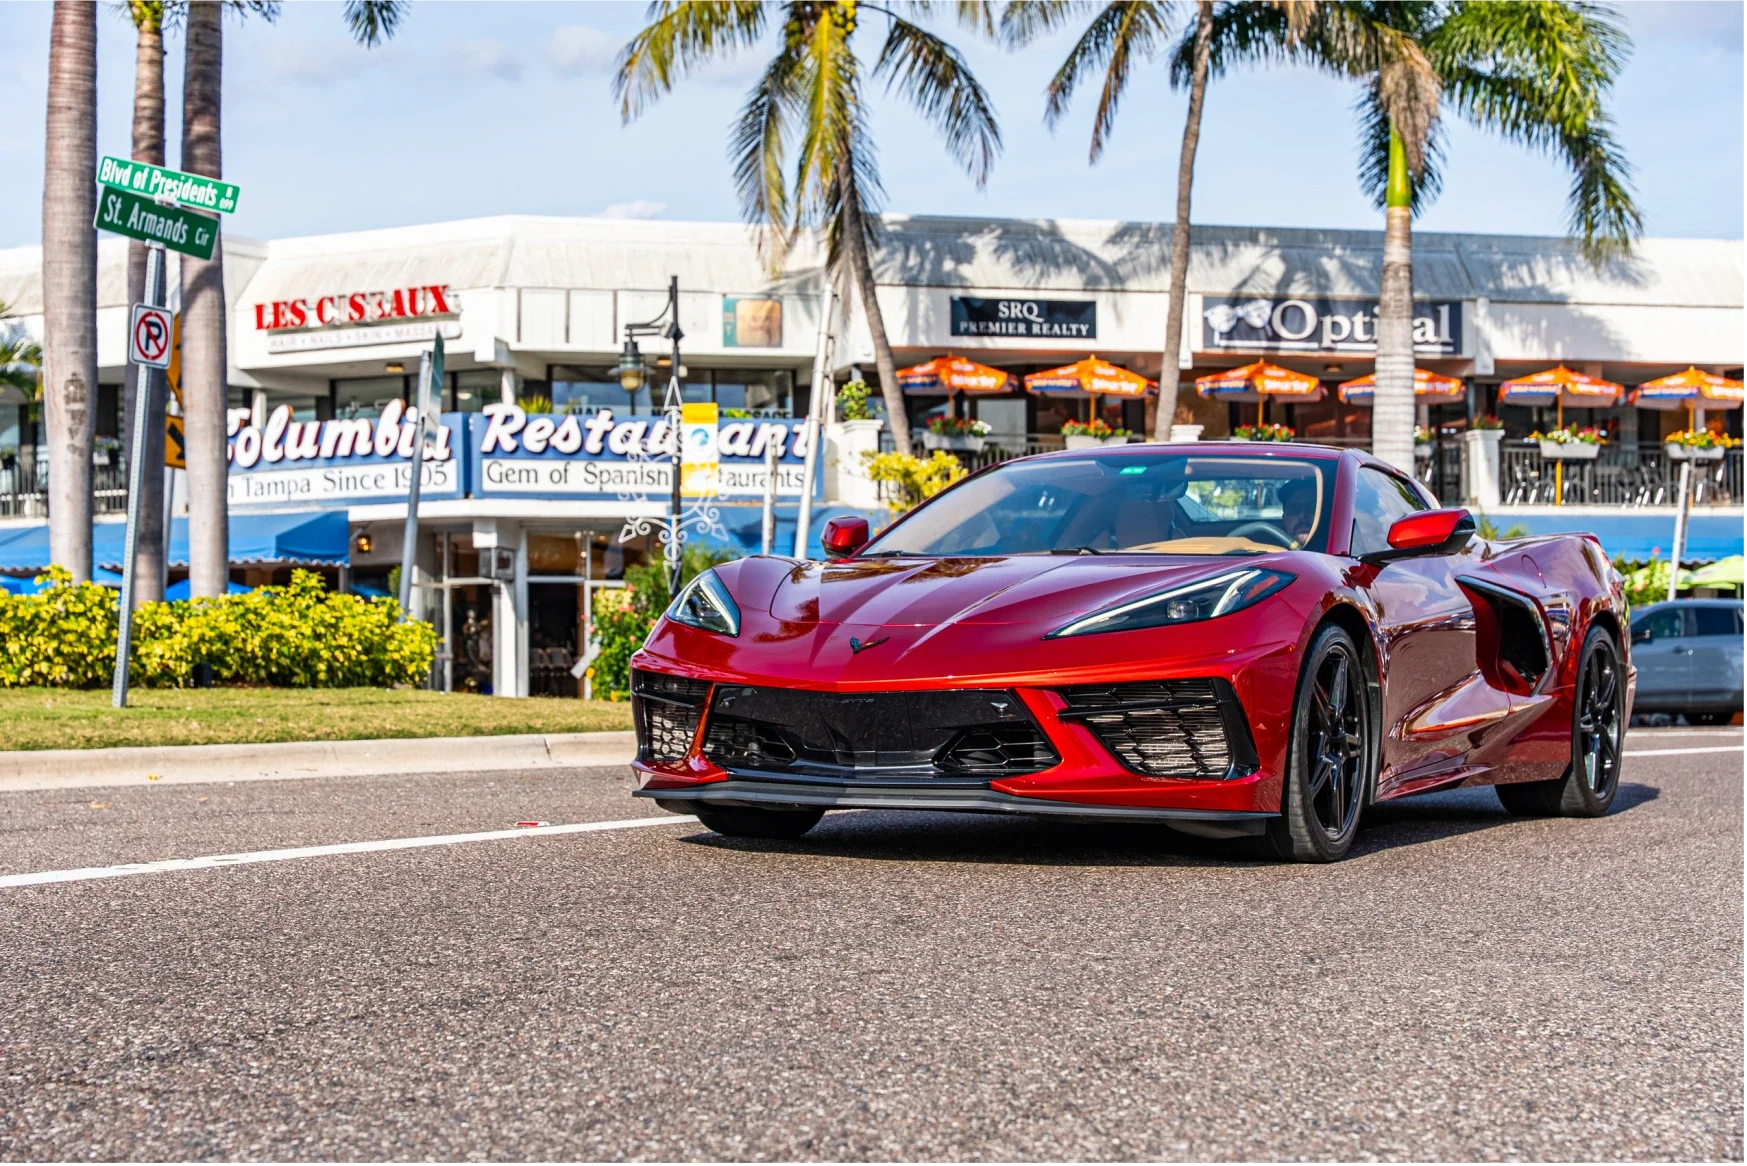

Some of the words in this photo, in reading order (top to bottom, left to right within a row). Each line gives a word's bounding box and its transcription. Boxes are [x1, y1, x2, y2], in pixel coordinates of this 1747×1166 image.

[100, 158, 132, 187] Blvd
[133, 167, 149, 190] of
[149, 169, 217, 207] Presidents
[226, 186, 233, 198] N
[219, 197, 234, 210] 099
[103, 194, 122, 226] St.
[126, 202, 188, 244] Armands
[194, 227, 210, 246] Cir
[255, 299, 307, 330] LES
[998, 301, 1044, 323] SRQ
[1271, 300, 1454, 348] Optial
[394, 323, 448, 339] MASSAE
[959, 321, 1027, 335] PREMIER
[1032, 322, 1090, 337] REALTY
[480, 402, 811, 455] Restauant
[242, 475, 311, 501] Tampa
[322, 468, 386, 492] Since
[486, 460, 539, 485] Gem
[549, 461, 571, 485] of
[583, 461, 670, 491] Spanish
